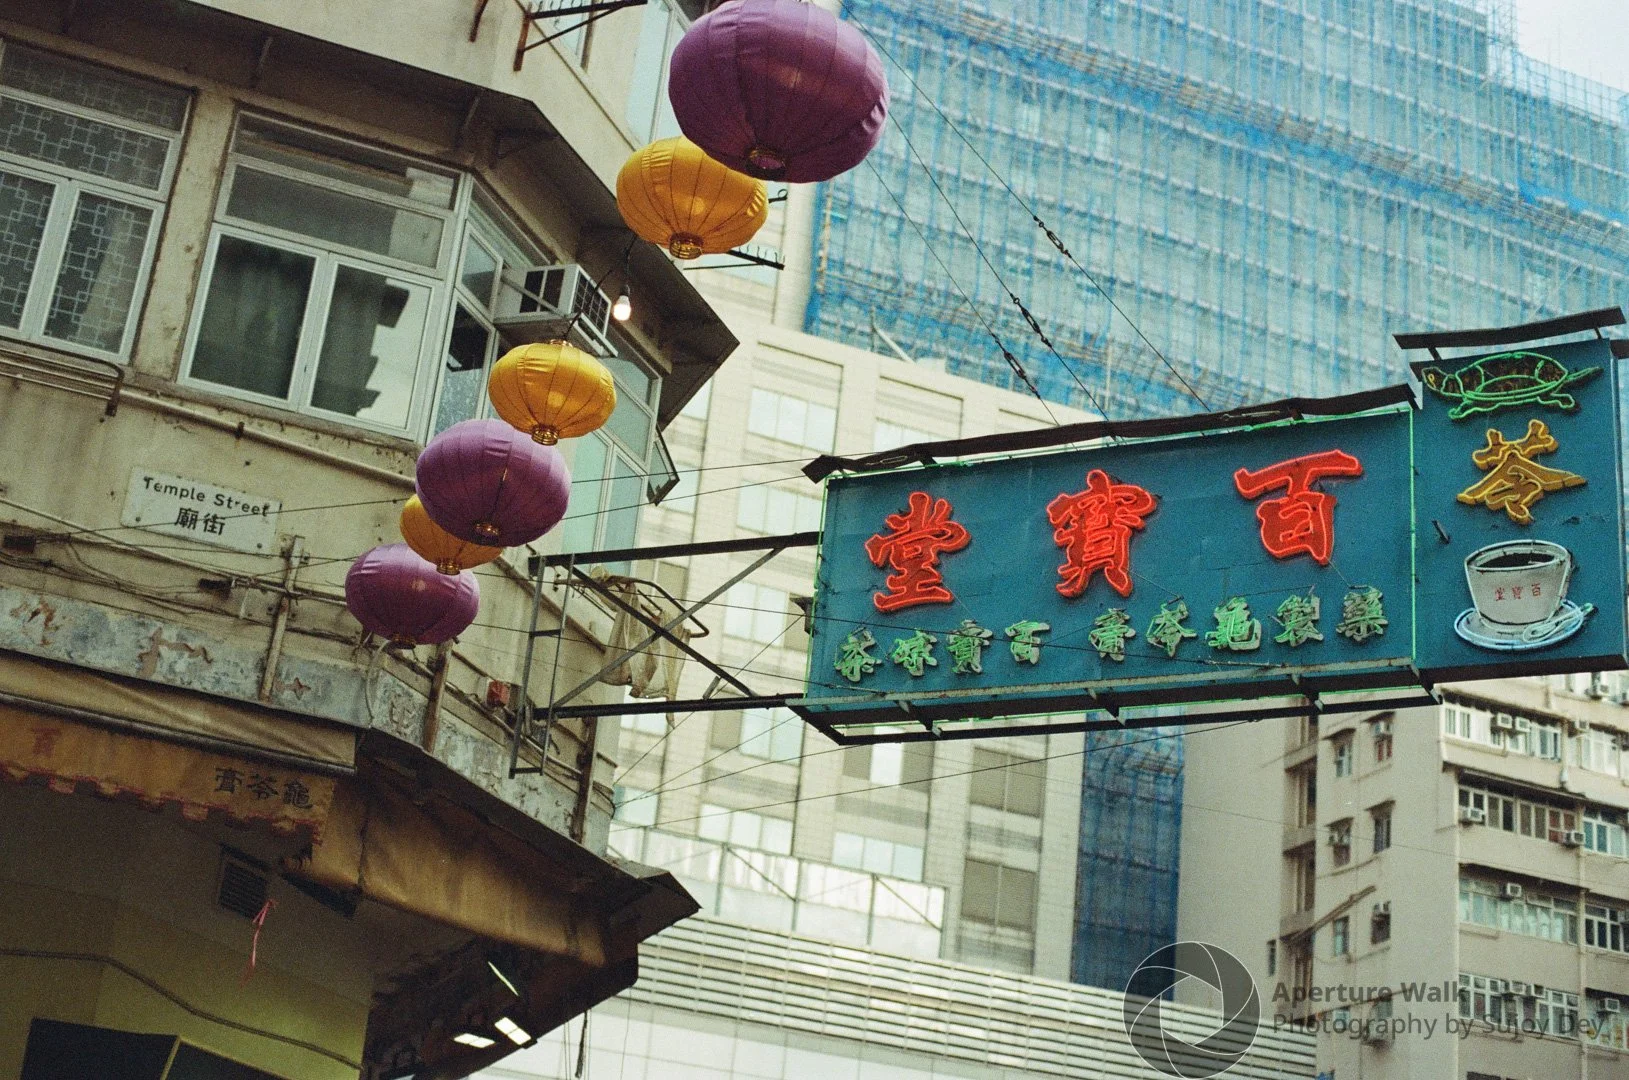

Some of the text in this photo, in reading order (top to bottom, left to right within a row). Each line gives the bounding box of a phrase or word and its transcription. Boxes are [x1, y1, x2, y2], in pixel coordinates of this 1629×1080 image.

[1456, 418, 1588, 526] 苓
[143, 476, 270, 517] Temple Street
[174, 507, 225, 536] 廟街
